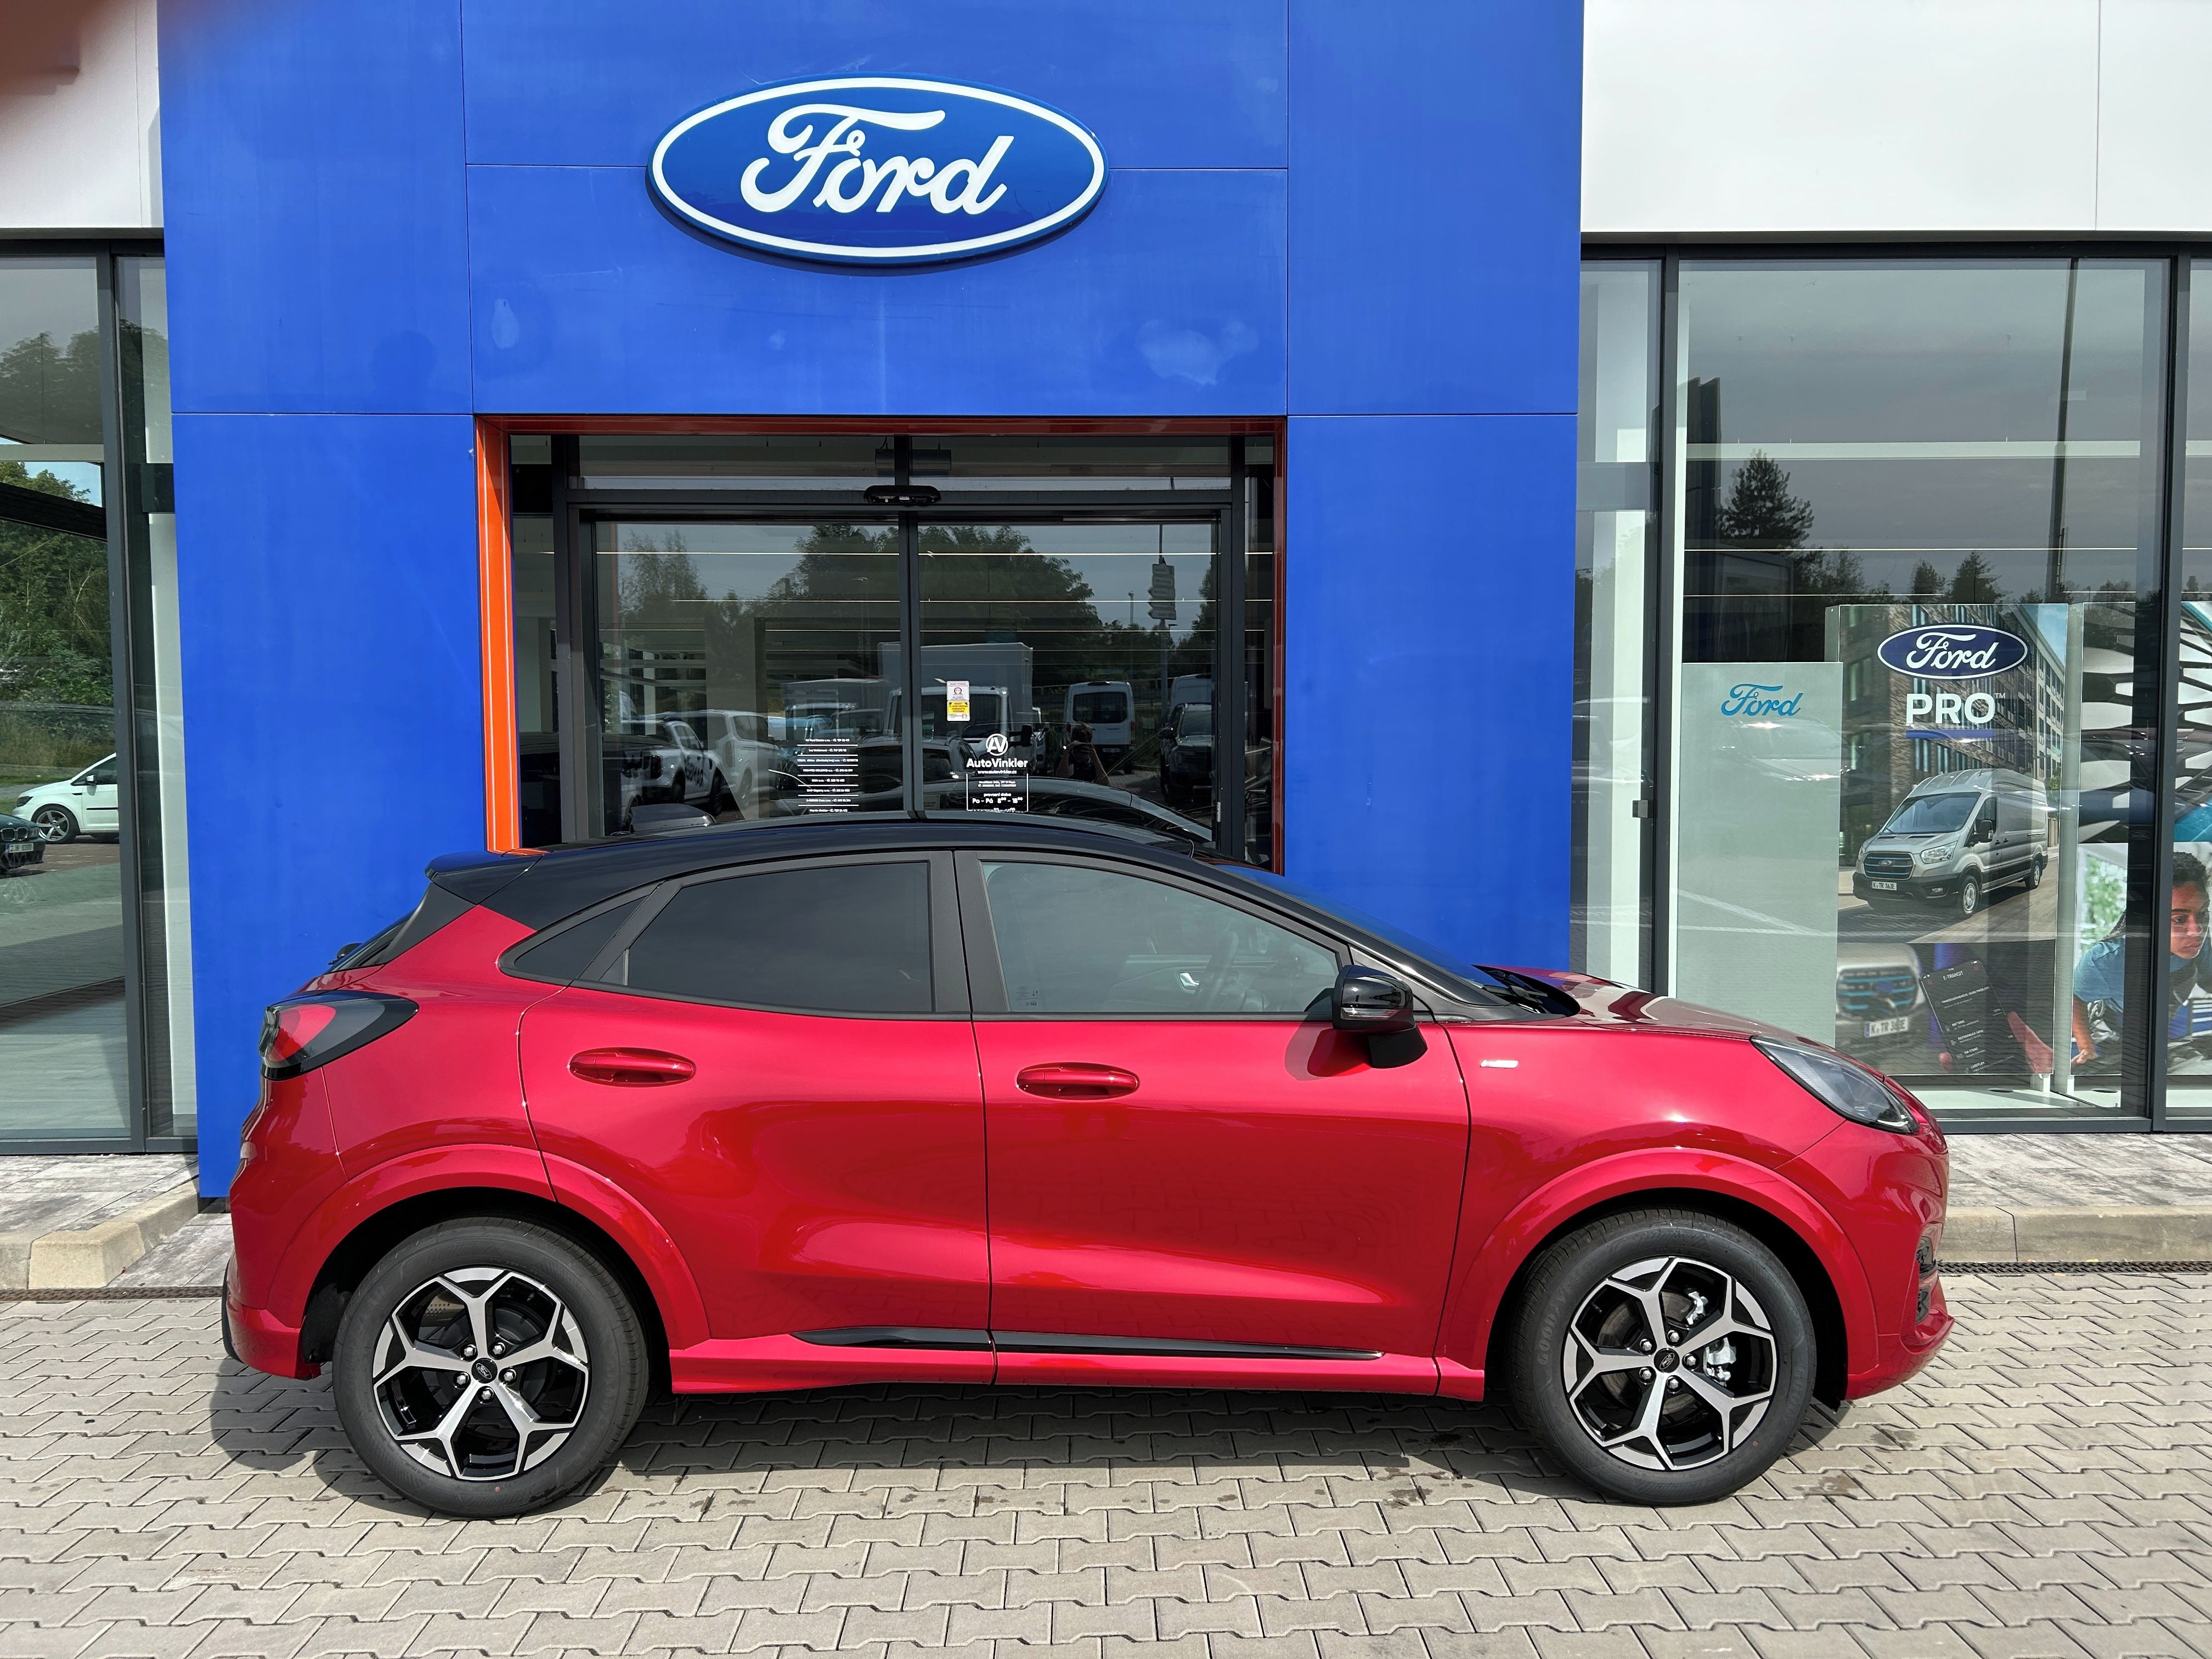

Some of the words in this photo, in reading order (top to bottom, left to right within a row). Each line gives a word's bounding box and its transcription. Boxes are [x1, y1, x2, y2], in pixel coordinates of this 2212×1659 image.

[741, 103, 1014, 215] Ford
[1905, 632, 2000, 669] Ford
[1721, 684, 1804, 716] Ford
[1906, 692, 1996, 724] PRO
[966, 758, 1028, 768] AutoVinkler
[1943, 970, 1963, 980] E-TRANSIT
